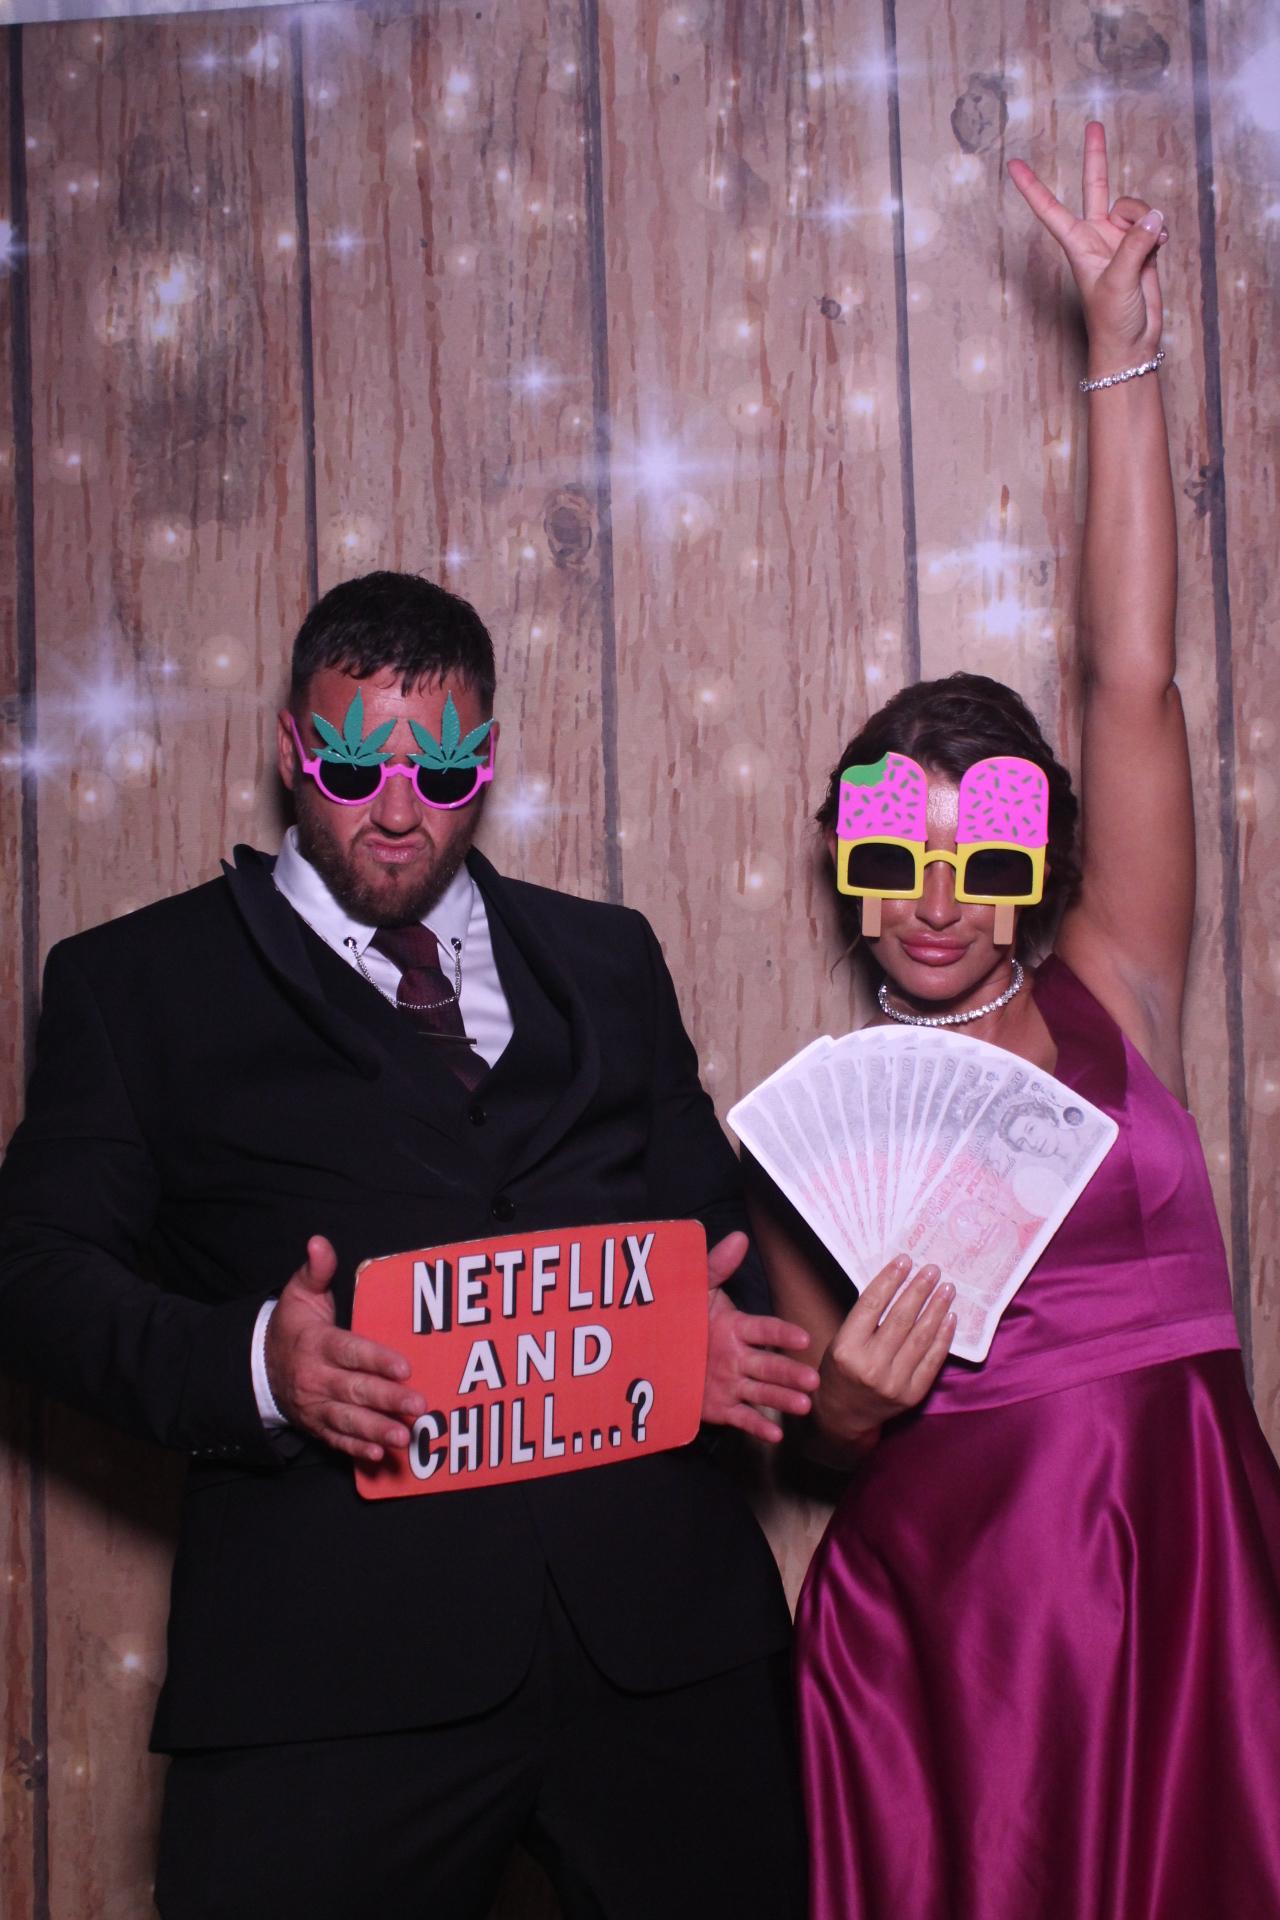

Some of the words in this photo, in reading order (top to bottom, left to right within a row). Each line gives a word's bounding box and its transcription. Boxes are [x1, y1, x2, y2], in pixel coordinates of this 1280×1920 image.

[412, 1232, 656, 1335] NETFLIX
[457, 1323, 613, 1395] AND
[408, 1377, 655, 1481] CHILL...?
